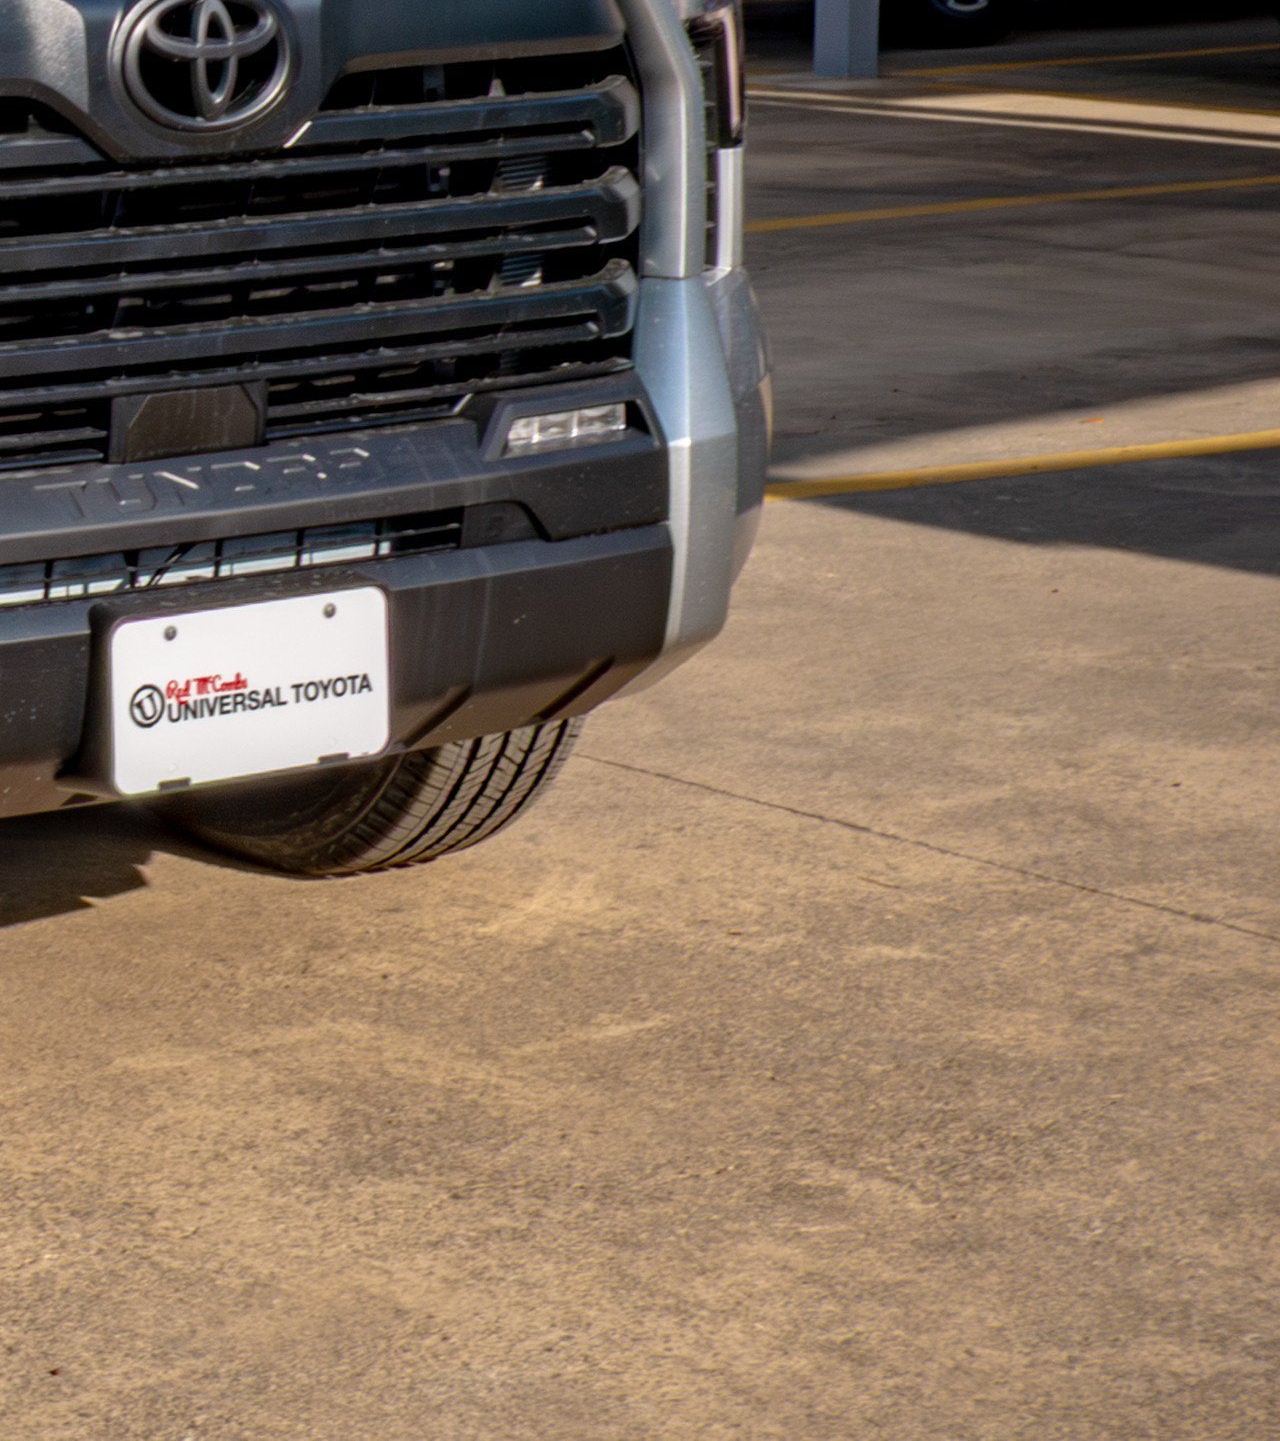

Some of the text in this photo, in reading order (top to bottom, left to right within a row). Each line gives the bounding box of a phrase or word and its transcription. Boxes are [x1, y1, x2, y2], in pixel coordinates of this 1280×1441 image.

[165, 679, 190, 704] Red
[167, 673, 373, 724] UNIVERSAL TOYOTA
